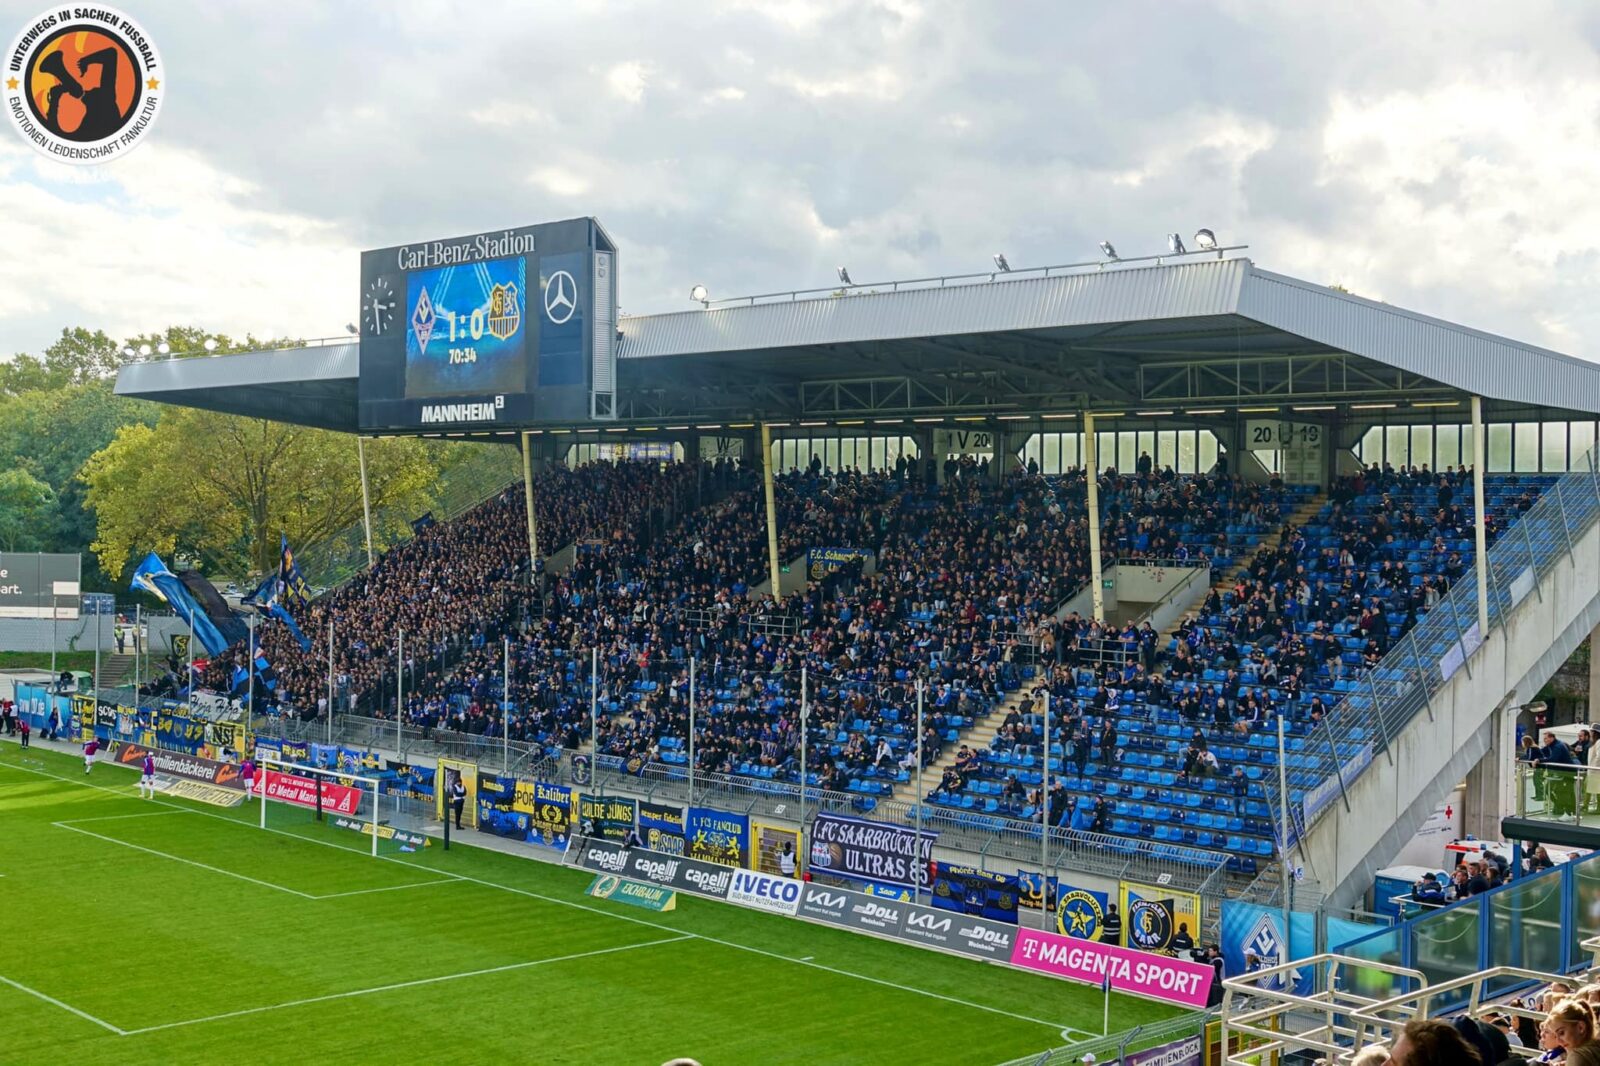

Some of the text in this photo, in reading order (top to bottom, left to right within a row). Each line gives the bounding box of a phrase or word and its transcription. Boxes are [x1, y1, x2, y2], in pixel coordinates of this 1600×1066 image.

[398, 230, 535, 270] Carl-Benz-Stadion
[448, 308, 484, 342] 1:0
[449, 347, 477, 364] 70:34
[421, 402, 496, 423] MANNHEIM
[957, 431, 969, 449] V
[1253, 426, 1272, 443] 20
[150, 754, 217, 780] amilienbäckerei
[266, 783, 336, 808] IG Metall Manneim
[840, 824, 933, 860] SAARBRÜCKN
[588, 849, 629, 867] capelli
[602, 862, 625, 872] SPORT
[635, 858, 678, 876] capelli
[845, 849, 906, 879] ULTRAS
[651, 873, 674, 883] SPORT
[685, 868, 729, 887] capelli
[734, 872, 799, 903] IVECO
[702, 884, 726, 894] SPORT
[1038, 942, 1131, 981] MAGENTA
[1134, 964, 1203, 996] SPORT
